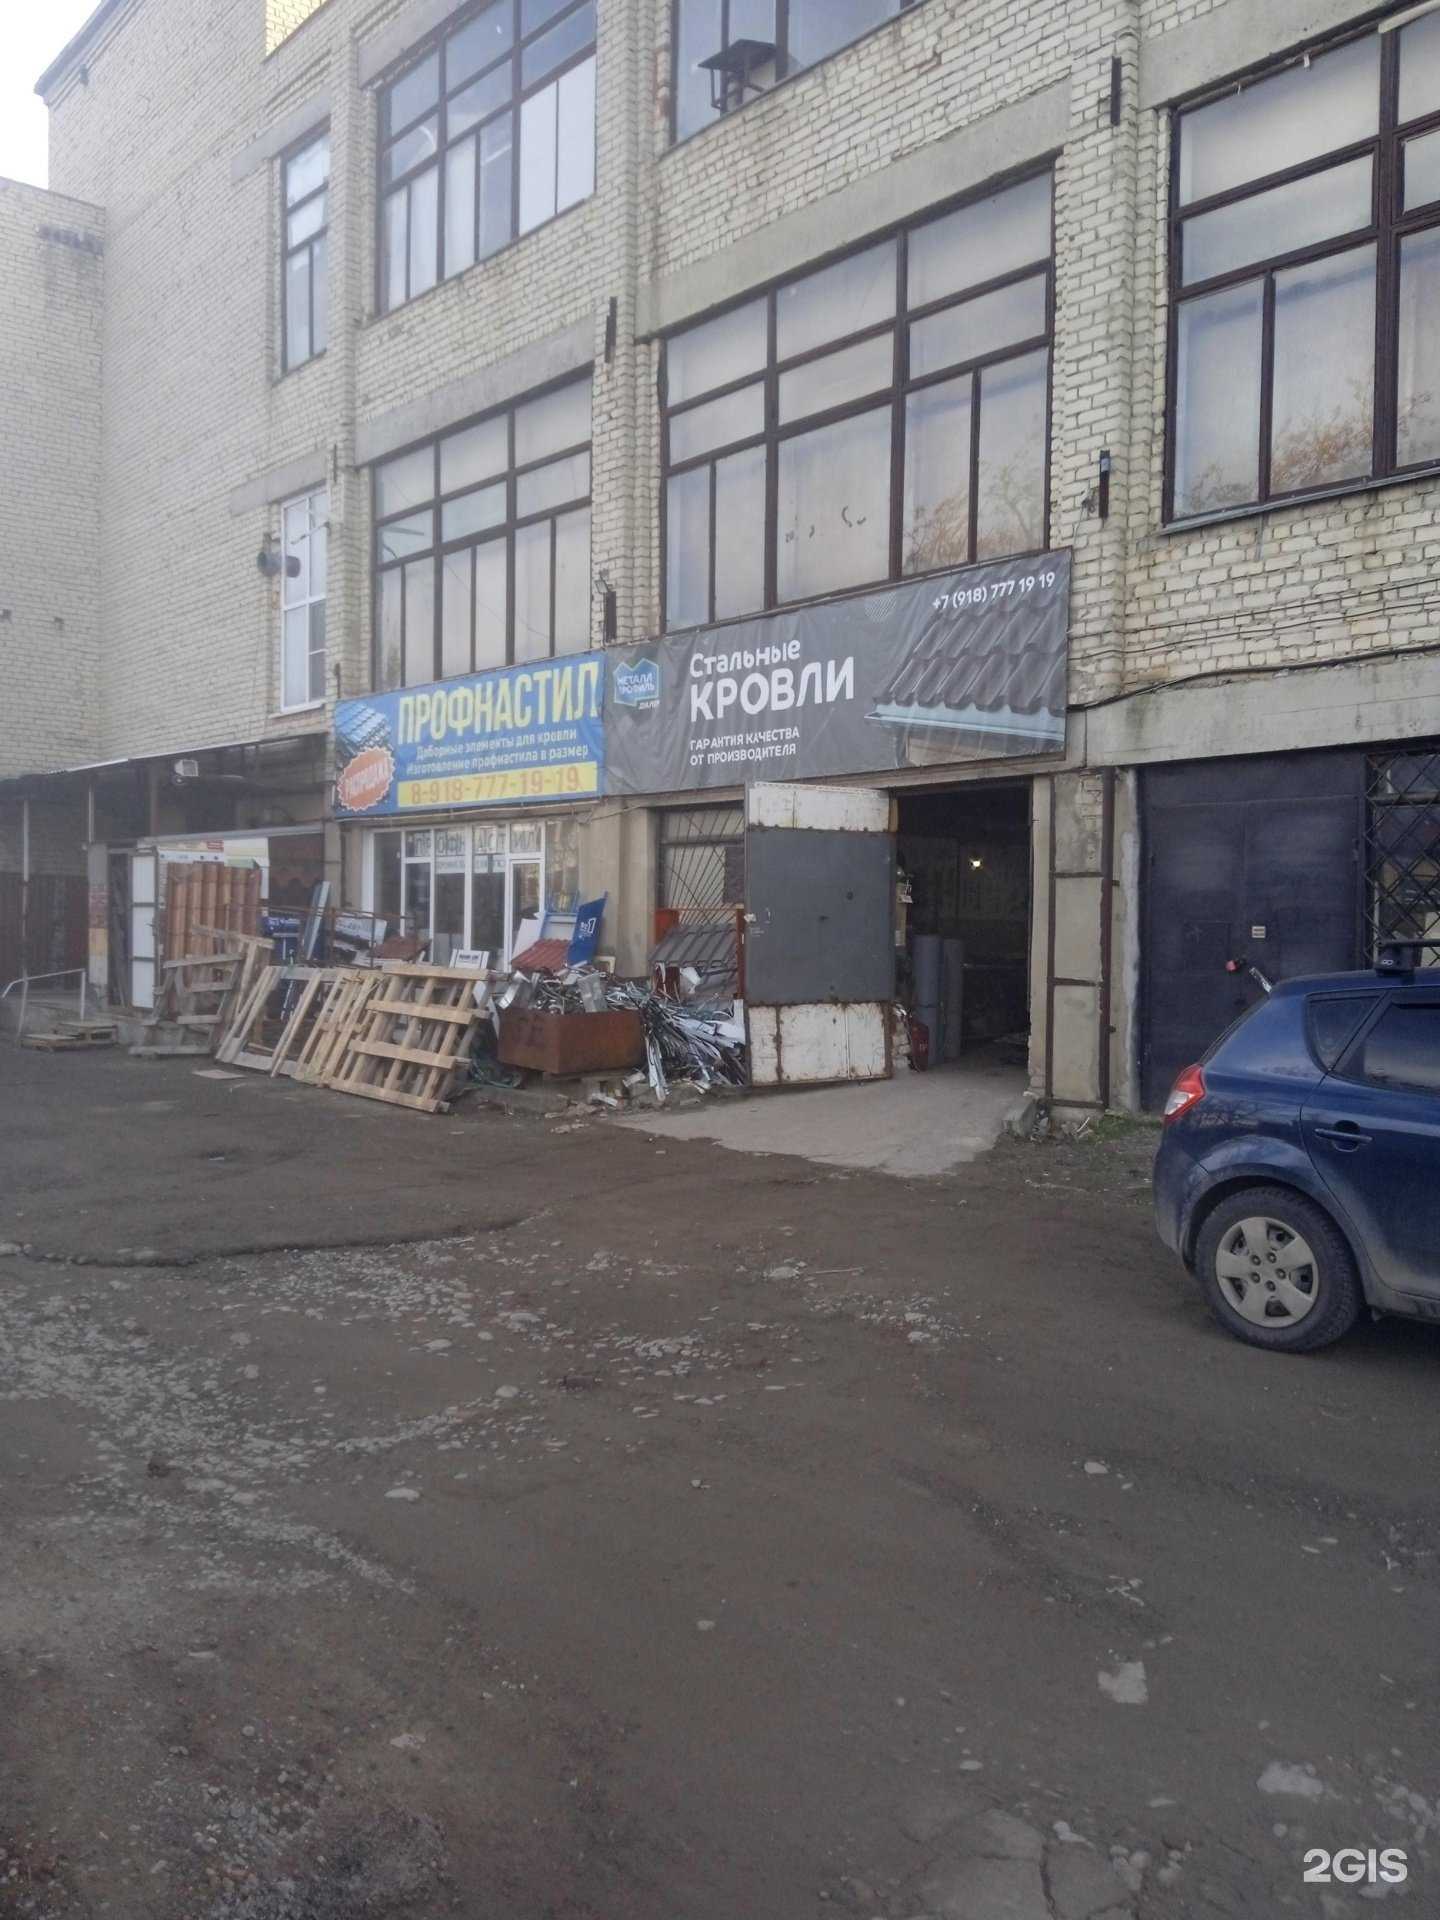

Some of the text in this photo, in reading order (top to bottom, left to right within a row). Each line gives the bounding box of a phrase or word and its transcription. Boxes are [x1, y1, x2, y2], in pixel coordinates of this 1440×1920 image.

[932, 571, 1055, 609] +7 (918) 777 19 19
[690, 639, 801, 678] Стальные
[397, 660, 600, 745] ПРОФНАСТИЛ
[690, 656, 855, 723] КРОВЛИ
[465, 736, 515, 752] элементы
[516, 732, 536, 748] для
[538, 728, 578, 746] кровли
[472, 749, 538, 771] профнастила
[550, 743, 589, 761] размер
[690, 726, 801, 751] ГАРАНТИЯ КАЧЕСТВА
[690, 743, 797, 766] ОТ ПРОИЗВОДИТЕЛЯ
[410, 765, 581, 805] 8-918-777-19-19
